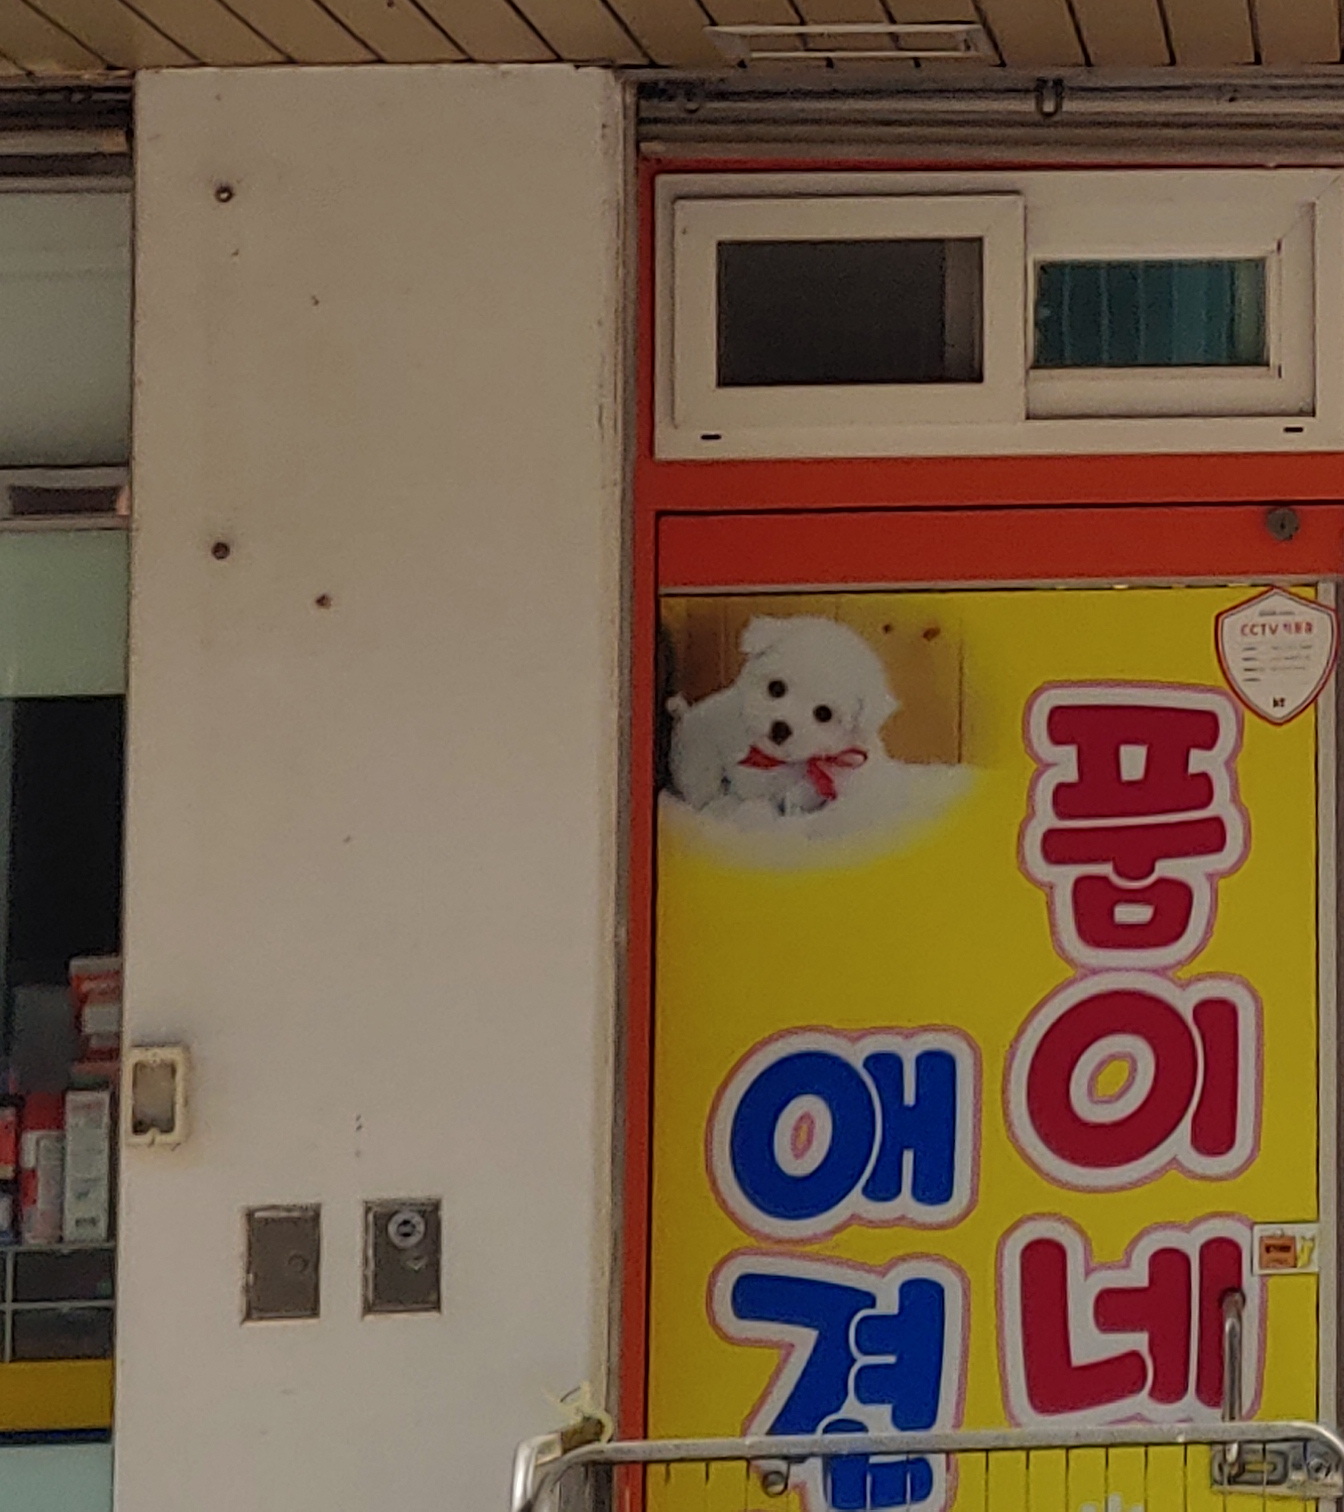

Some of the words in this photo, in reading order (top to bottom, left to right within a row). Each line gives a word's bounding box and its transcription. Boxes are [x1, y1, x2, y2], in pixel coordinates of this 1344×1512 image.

[1240, 622, 1279, 637] CCTV
[726, 1048, 958, 1511] 애견
[1015, 698, 1250, 1418] 품이네
